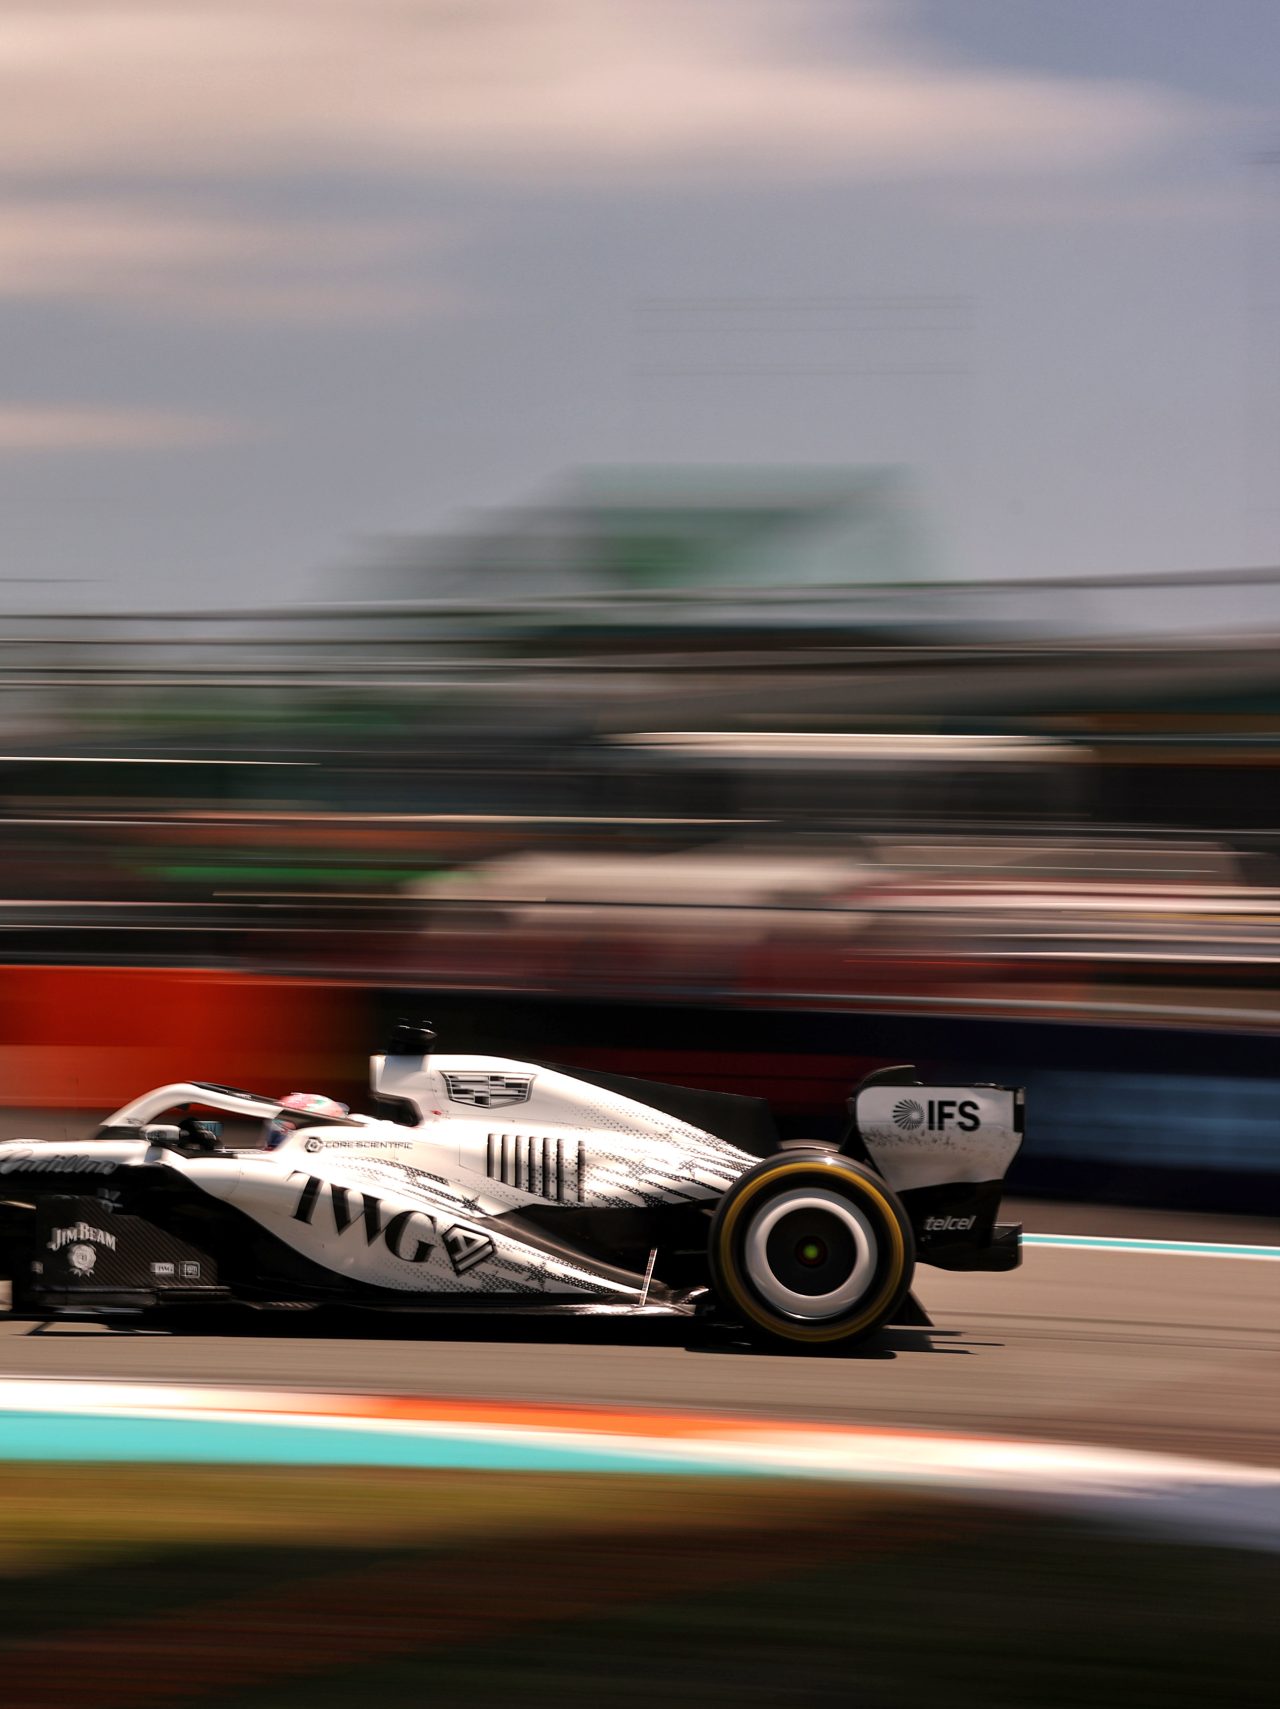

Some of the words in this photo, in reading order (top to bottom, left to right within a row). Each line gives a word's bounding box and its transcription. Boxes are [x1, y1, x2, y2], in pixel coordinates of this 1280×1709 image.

[928, 1100, 981, 1132] IFS
[325, 1140, 354, 1149] CORE
[923, 1215, 977, 1231] telcel
[47, 1227, 78, 1251] JIM
[75, 1221, 118, 1252] BEAM
